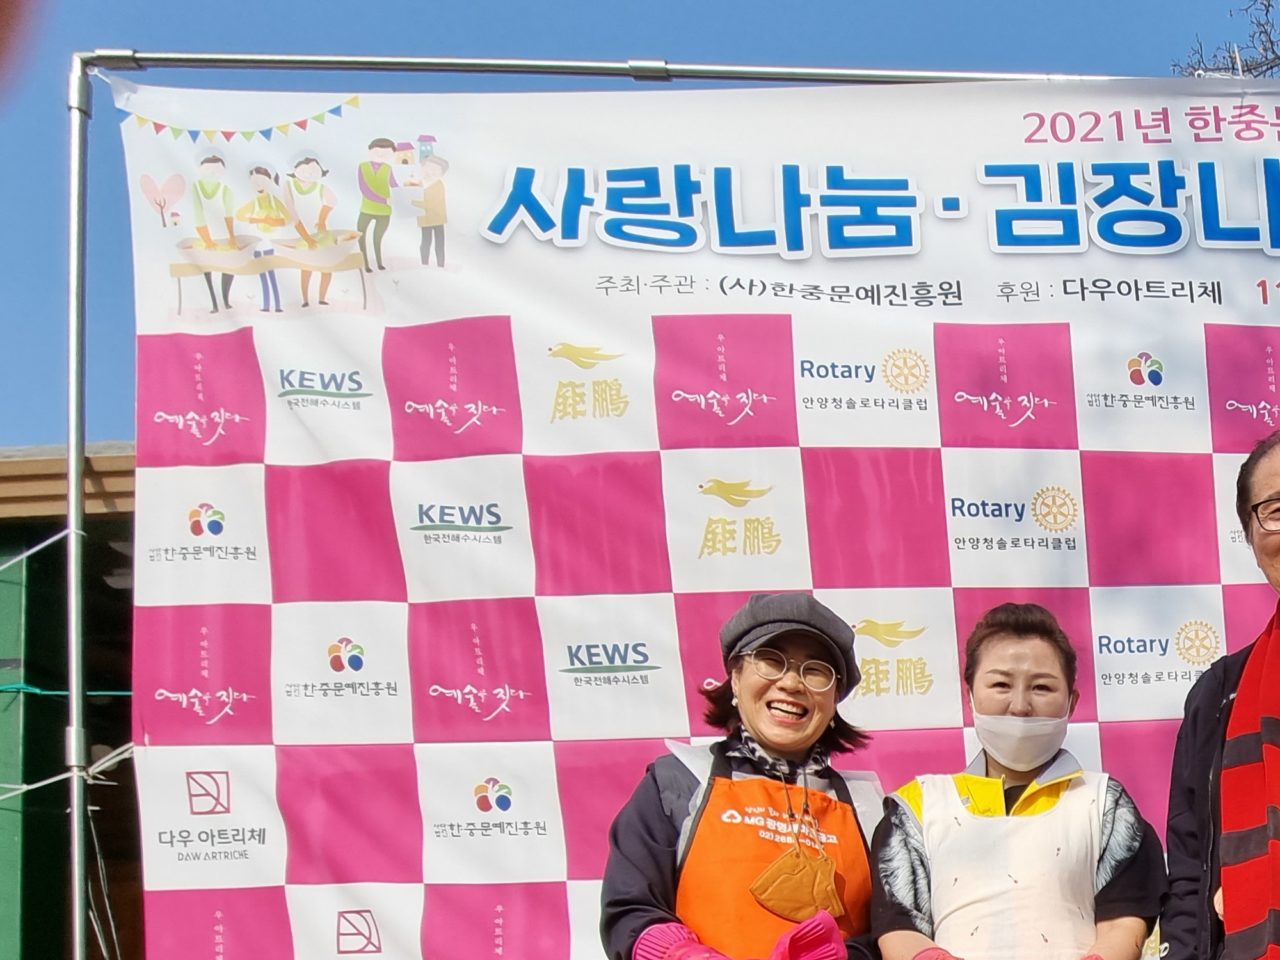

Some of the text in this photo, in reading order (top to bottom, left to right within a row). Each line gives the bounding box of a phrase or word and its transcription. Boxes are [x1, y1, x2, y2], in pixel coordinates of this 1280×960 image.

[1022, 107, 1172, 144] 2021년
[717, 277, 965, 307] (사)한중문예진흥원
[1062, 279, 1223, 305] 다우아트리체
[279, 368, 363, 392] KEWS
[801, 360, 875, 382] Rotary
[802, 397, 928, 411] 안양청솔로타리클럽
[418, 504, 502, 525] KEWS
[951, 498, 1025, 522] Rotary
[424, 533, 502, 544] 한국전해수시스템
[954, 537, 1076, 550] 안양청솔로타리클럽
[567, 642, 649, 666] KEWS
[1098, 636, 1169, 656] Rotary
[573, 675, 648, 687] 한국전해수시스템
